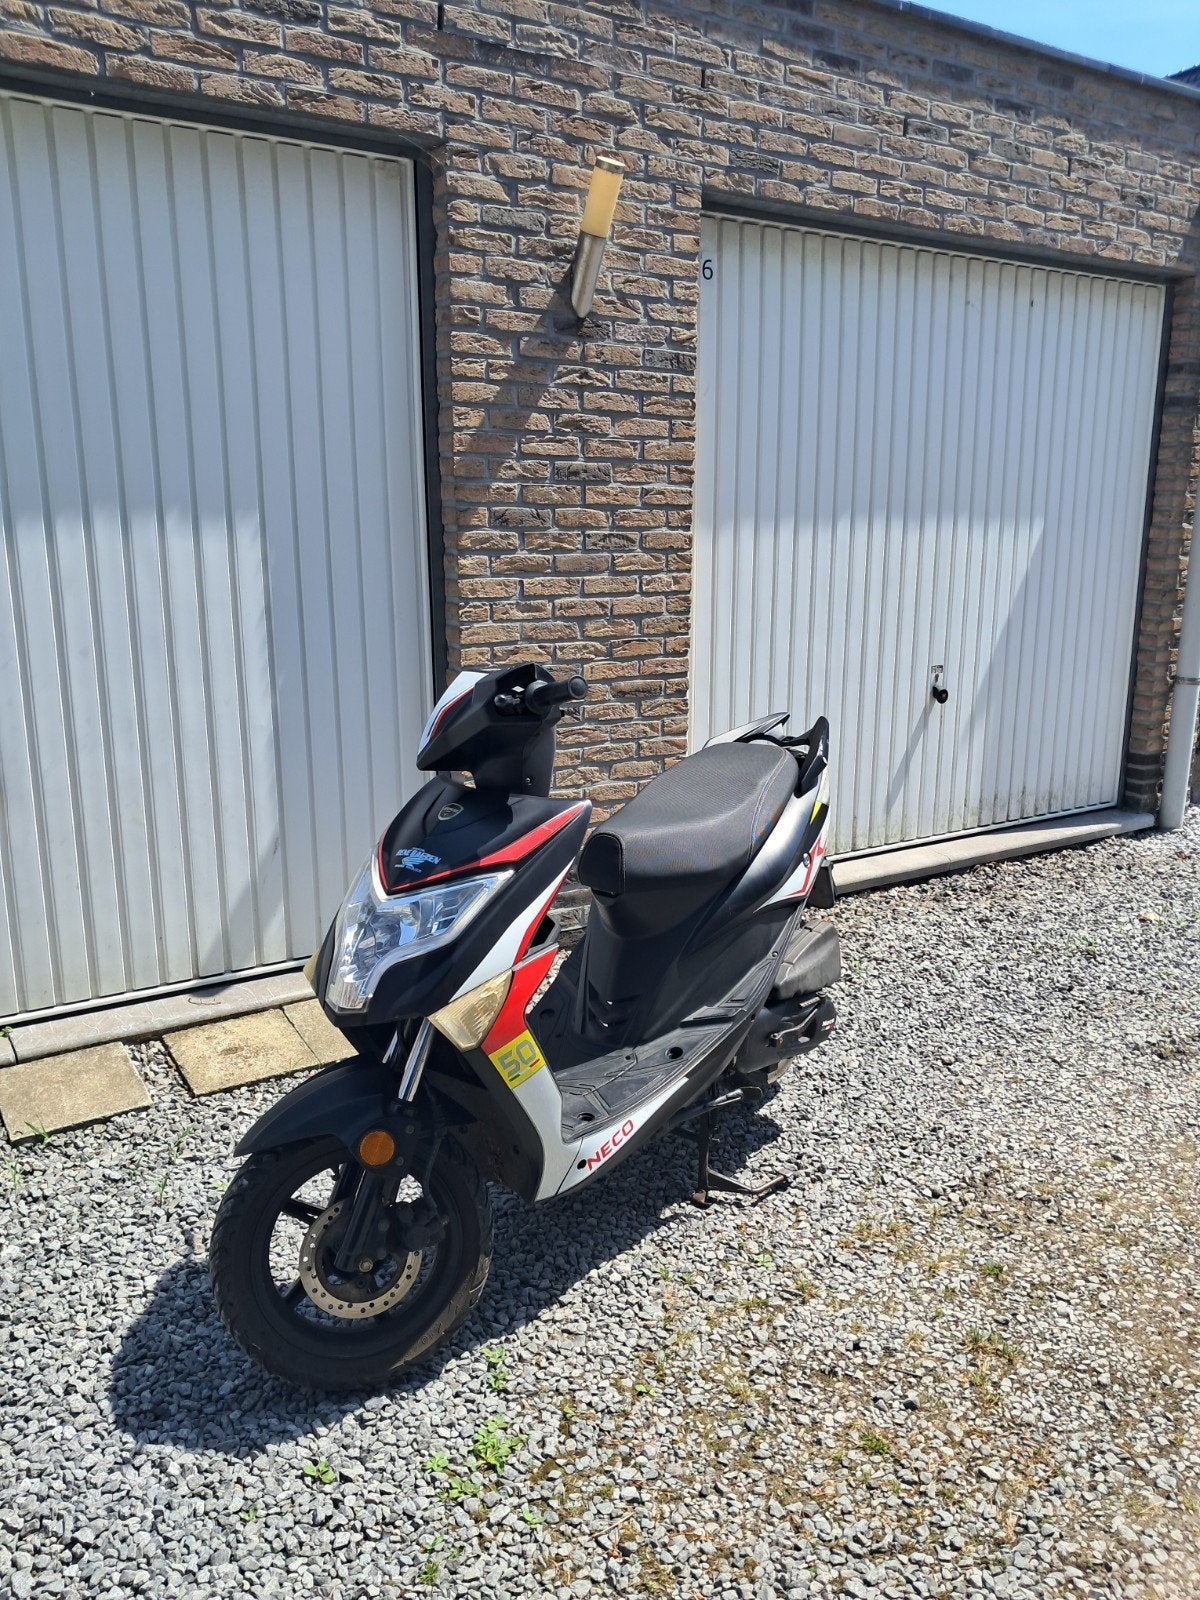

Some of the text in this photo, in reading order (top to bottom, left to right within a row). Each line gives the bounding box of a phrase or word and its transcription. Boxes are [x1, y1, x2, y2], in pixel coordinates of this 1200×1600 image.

[702, 259, 713, 280] 6
[498, 1039, 537, 1078] 50
[586, 1119, 634, 1171] NECO
